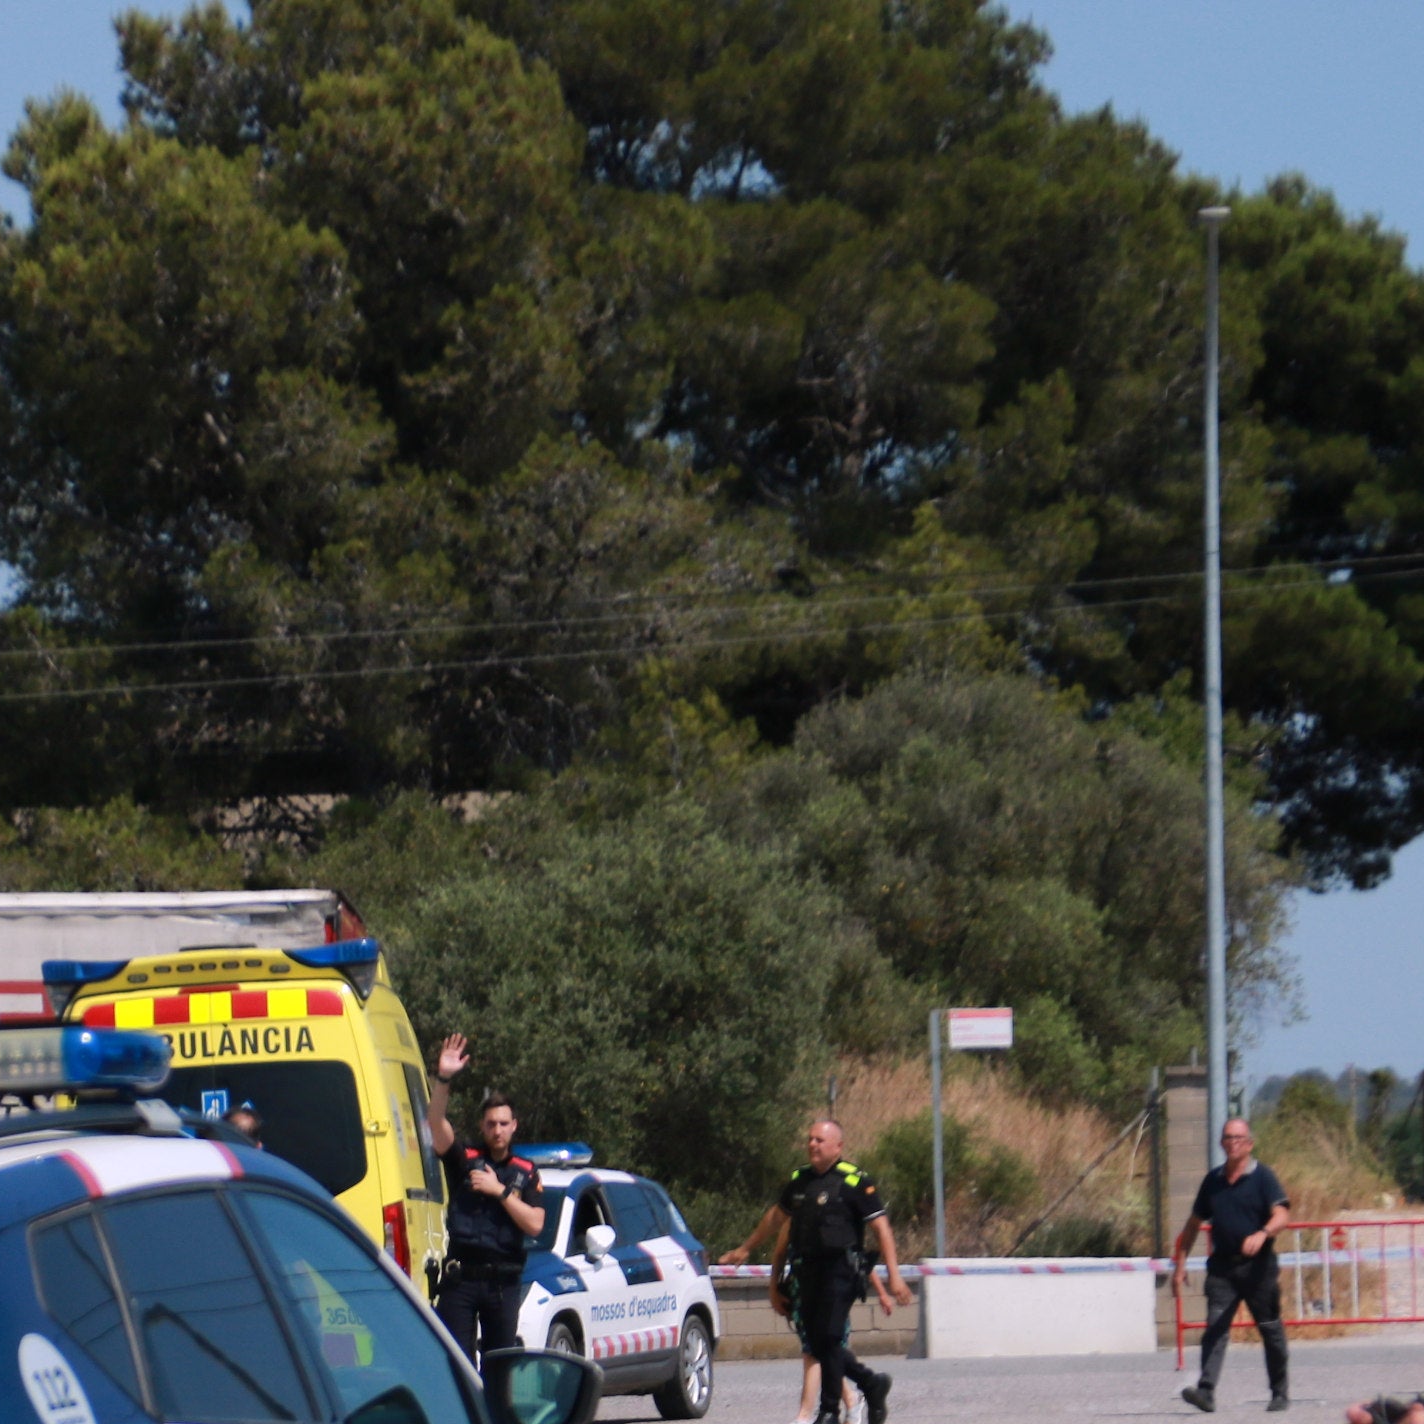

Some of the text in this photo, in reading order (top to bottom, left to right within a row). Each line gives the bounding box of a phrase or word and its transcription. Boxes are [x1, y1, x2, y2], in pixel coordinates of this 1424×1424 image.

[591, 1291, 677, 1321] mossos d'esquadra
[33, 1367, 77, 1410] 112
